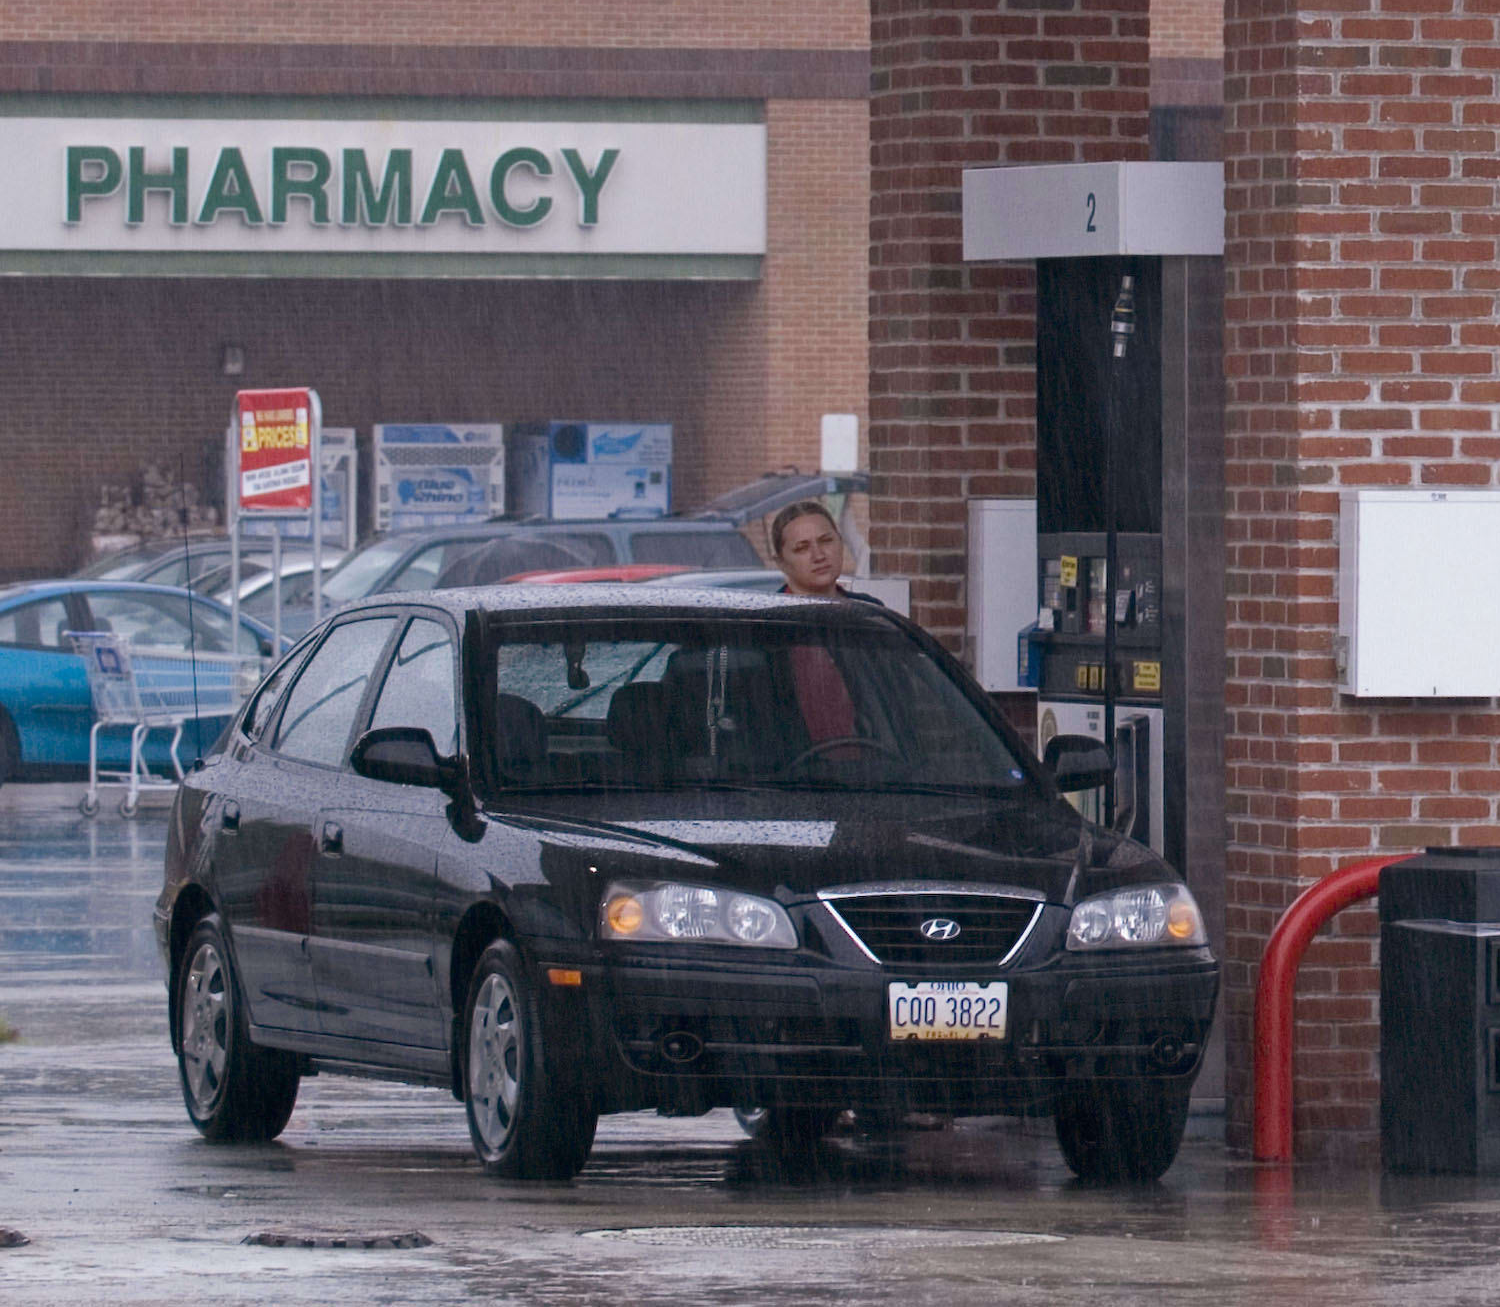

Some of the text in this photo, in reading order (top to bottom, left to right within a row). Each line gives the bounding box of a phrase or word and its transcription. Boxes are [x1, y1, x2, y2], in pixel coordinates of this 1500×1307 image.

[64, 144, 621, 228] PHARMACY
[1086, 192, 1097, 233] 2
[945, 997, 1001, 1029] 3822
